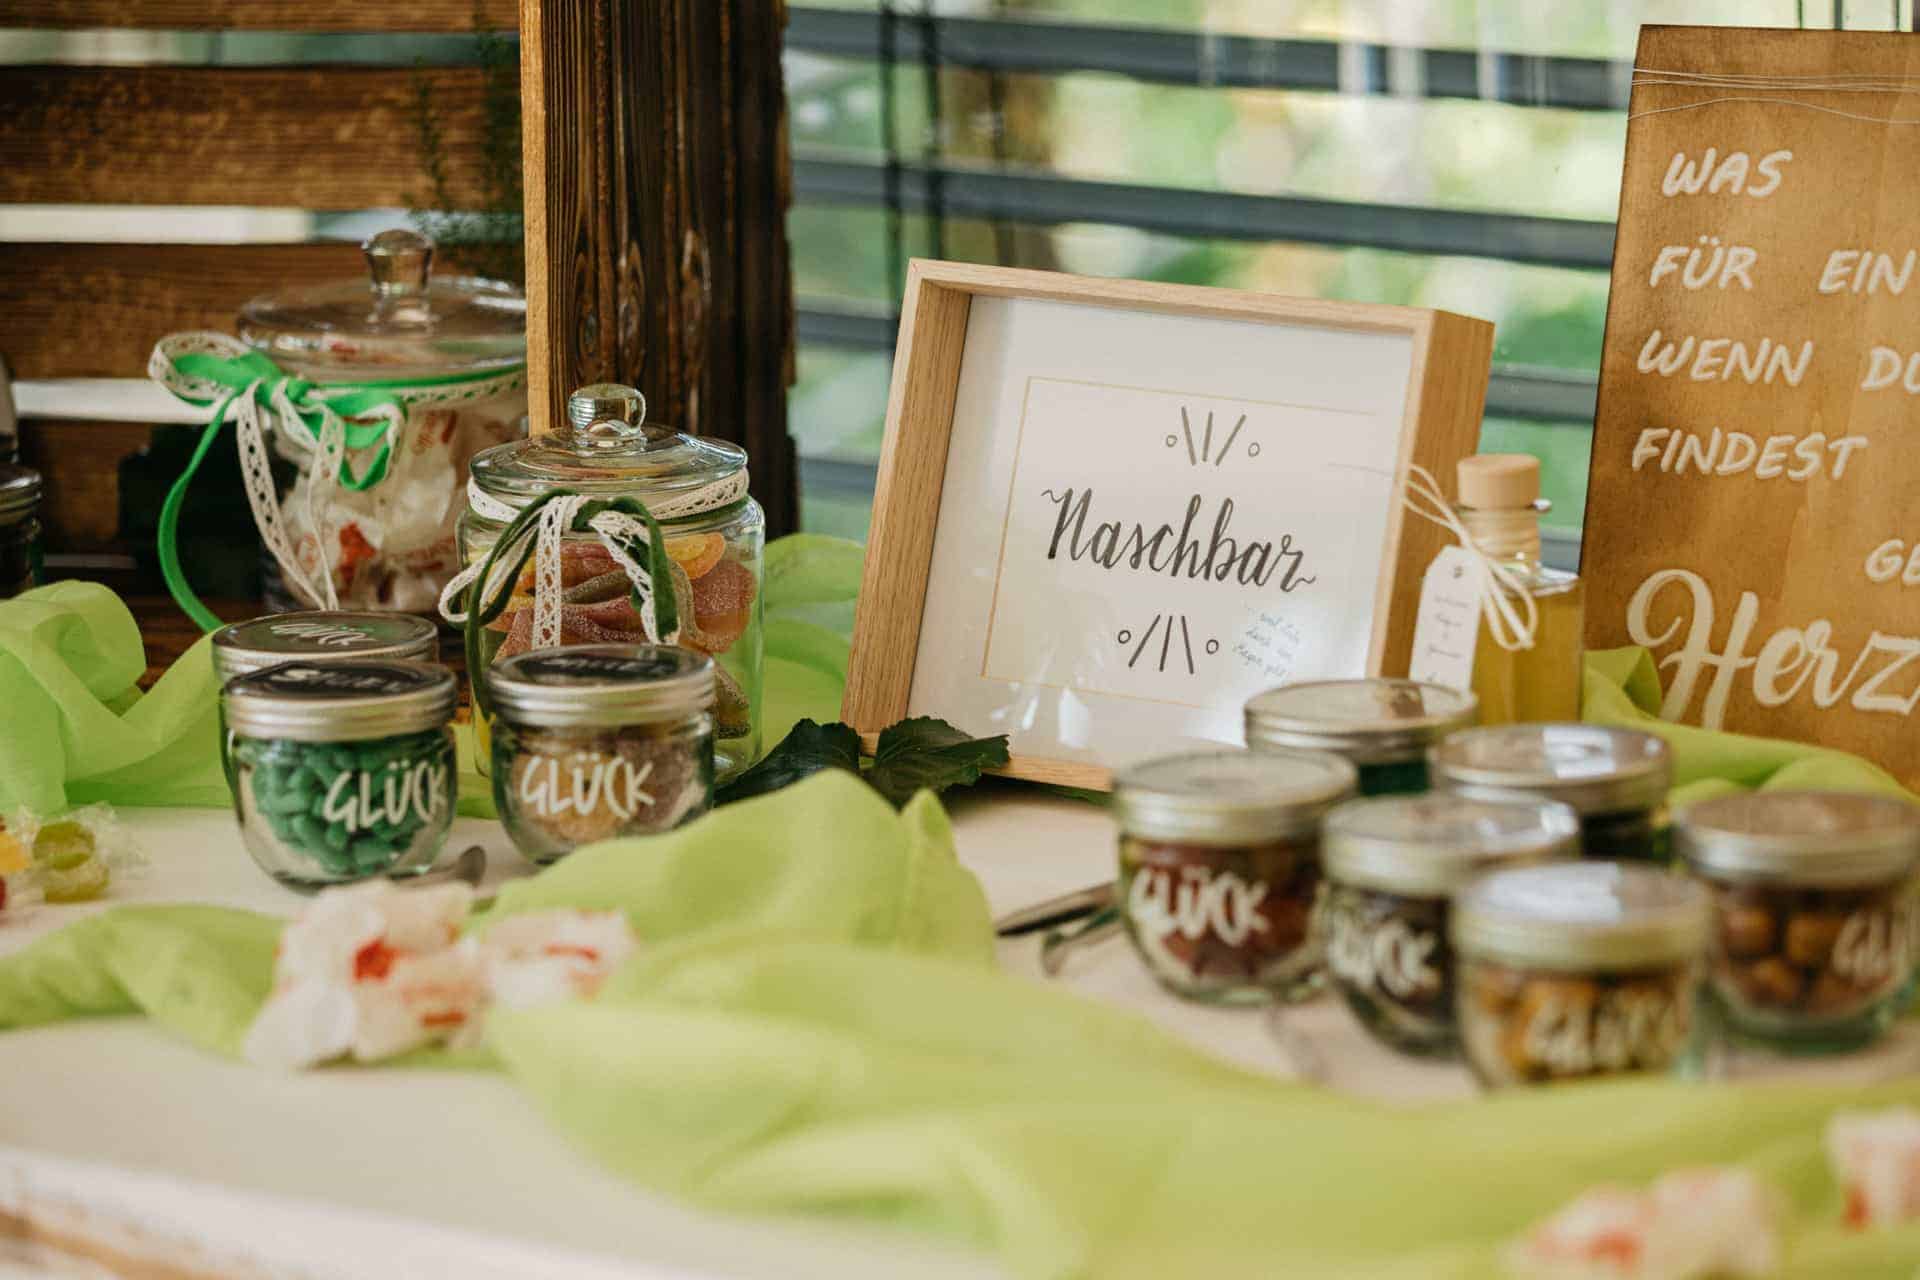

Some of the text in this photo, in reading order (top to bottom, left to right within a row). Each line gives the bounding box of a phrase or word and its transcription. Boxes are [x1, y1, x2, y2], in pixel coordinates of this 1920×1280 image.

[1662, 148, 1793, 197] WAS
[1649, 236, 1917, 296] FÜR EIN
[1637, 330, 1814, 386] WENN
[1631, 426, 1869, 480] FINDEST
[1041, 487, 1317, 593] Naschbar
[323, 757, 449, 834] GLÜCK
[521, 753, 656, 820] GLÜCK
